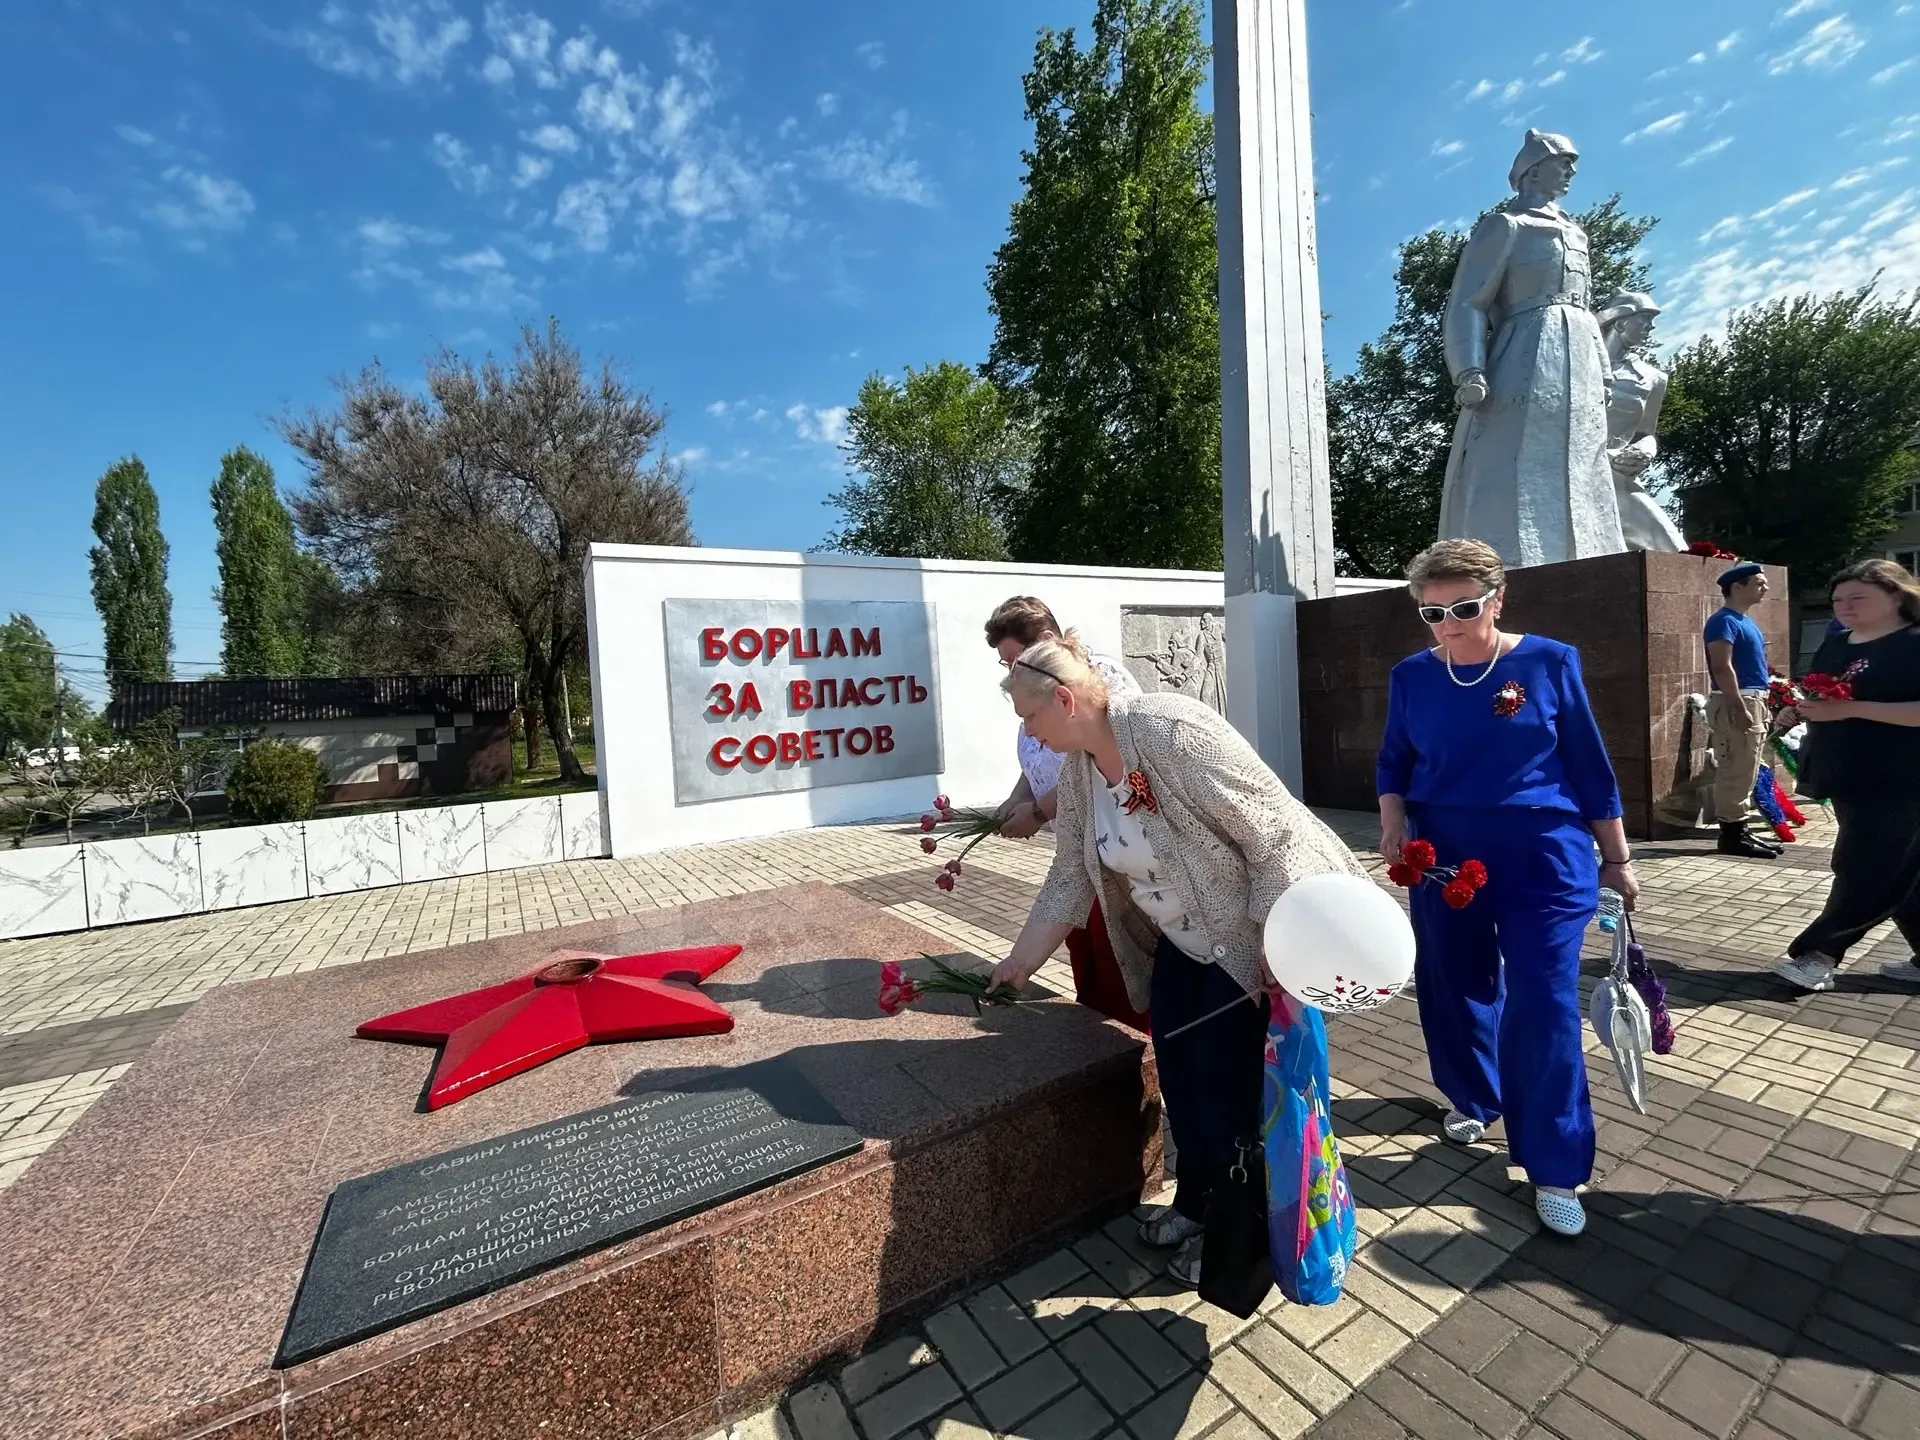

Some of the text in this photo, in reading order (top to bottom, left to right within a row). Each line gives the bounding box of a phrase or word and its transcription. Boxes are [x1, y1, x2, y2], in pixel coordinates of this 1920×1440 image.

[702, 627, 881, 659] БОРЦАМ
[707, 675, 928, 715] ЗА ВЛАСТЬ
[709, 725, 895, 768] СОВЕТОВ
[376, 1163, 532, 1219] ЗАМЕСТИТЕЛЮ
[540, 1118, 674, 1166] ПРЕДСЕДАТЕЛЯ
[391, 1106, 774, 1236] РАБОЧИХ СОЛДАТСКИХ И КРЕСТЬЯНСКИХ
[407, 1100, 764, 1220] БОРИСОГЛЕБСКОГО УЕЗДНОГО СОВЕТА
[420, 1143, 507, 1177] САВИНУ
[512, 1112, 609, 1150] НИКОЛАЮ
[544, 1133, 590, 1151] 1890
[607, 1112, 650, 1131] 1918
[363, 1227, 466, 1269] БОЙЦАМ
[476, 1219, 490, 1231] И
[499, 1166, 642, 1221] КОМАНДИРАМ
[650, 1154, 681, 1170] 337
[373, 1219, 592, 1306] РЕВОЛЮЦИОННЫХ
[599, 1171, 726, 1225] ЗАВОЕВАНИЙ
[394, 1136, 793, 1283] ОТДАВШИМ СВОИ ЖИЗНИ ПРИ ЗАЩИТЕ
[484, 1150, 727, 1240] ПОЛКА КРАСНОЙ АРМИИ
